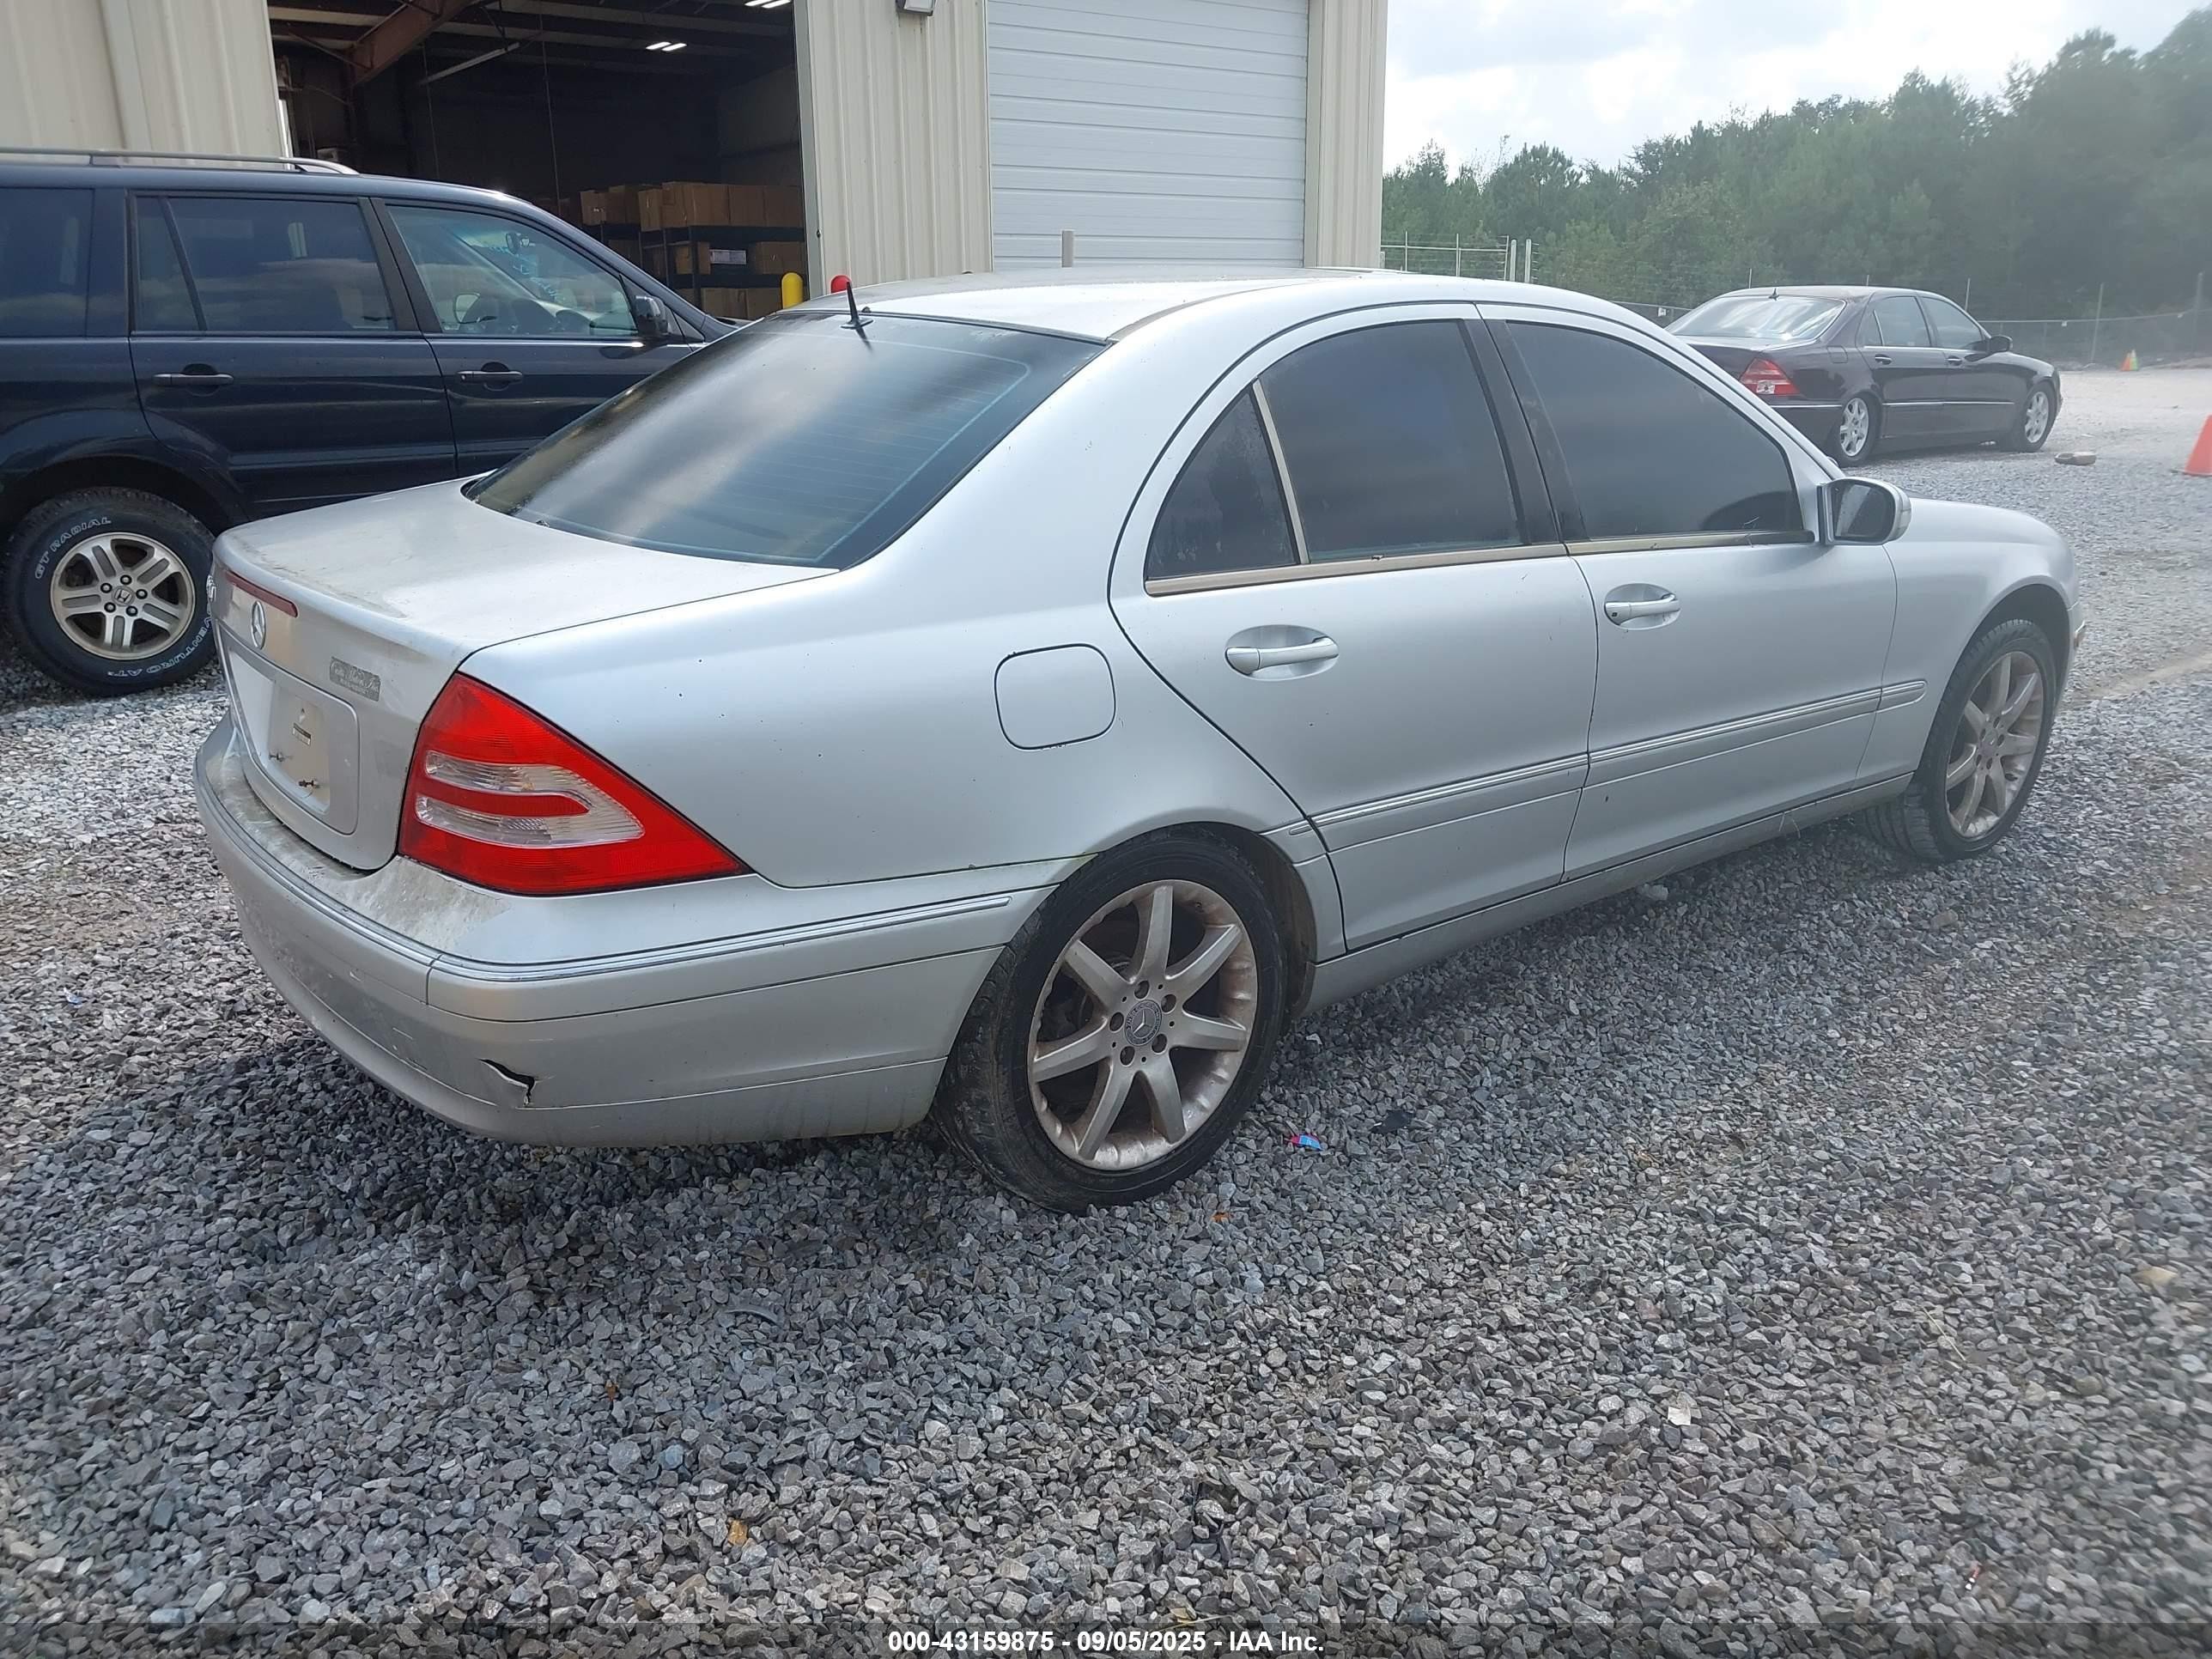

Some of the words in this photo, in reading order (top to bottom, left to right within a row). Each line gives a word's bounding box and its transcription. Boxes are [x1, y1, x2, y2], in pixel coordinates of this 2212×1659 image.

[35, 551, 50, 579] GT
[50, 517, 112, 552] RADIAL
[145, 613, 212, 673] VENTURO
